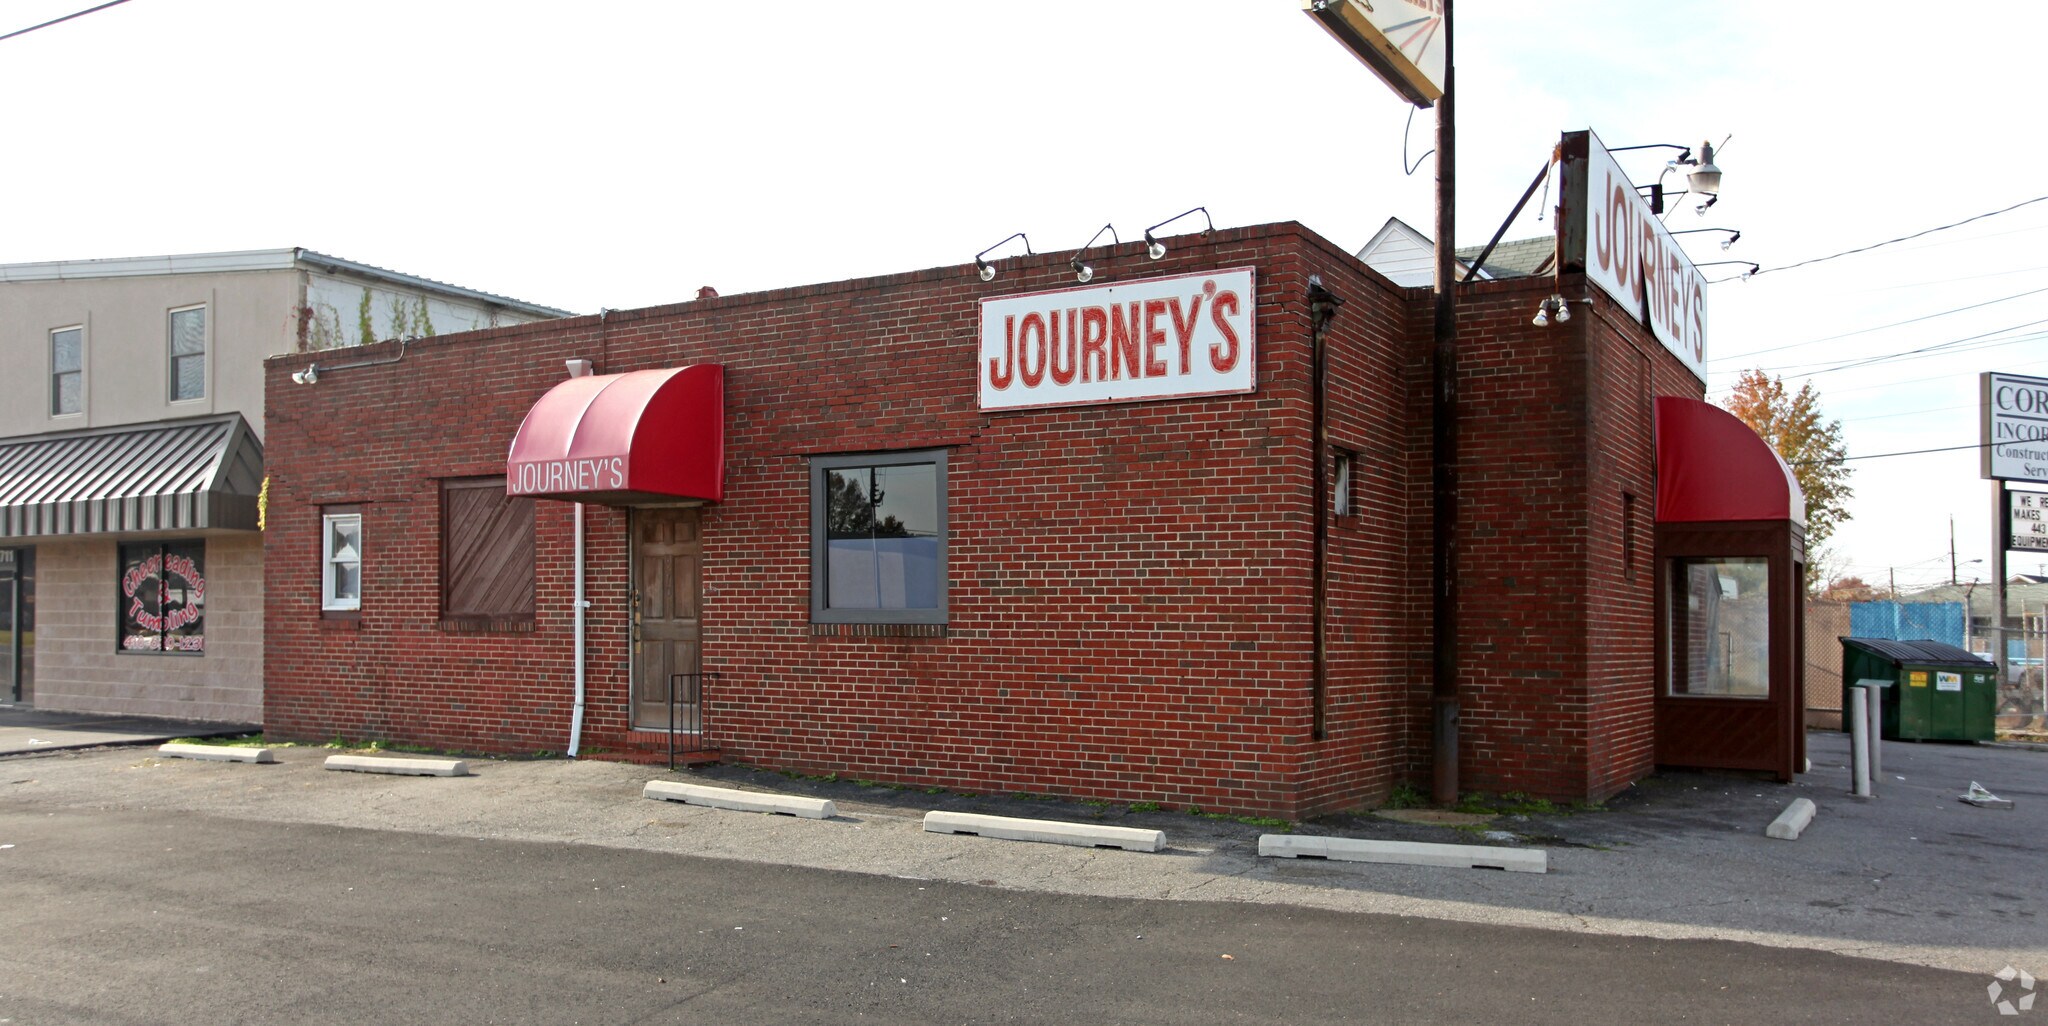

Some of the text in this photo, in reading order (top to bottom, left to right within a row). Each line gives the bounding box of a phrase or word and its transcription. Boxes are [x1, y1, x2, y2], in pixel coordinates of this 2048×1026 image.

[1594, 170, 1704, 364] JOURNEY'S
[989, 279, 1241, 392] JOURNEY'S
[1996, 385, 2048, 414] COR
[512, 457, 623, 493] JOURNEY'S
[2013, 509, 2041, 521] MAKES
[2020, 496, 2031, 507] WE
[2031, 523, 2046, 535] 443
[122, 553, 205, 599] Cheereading
